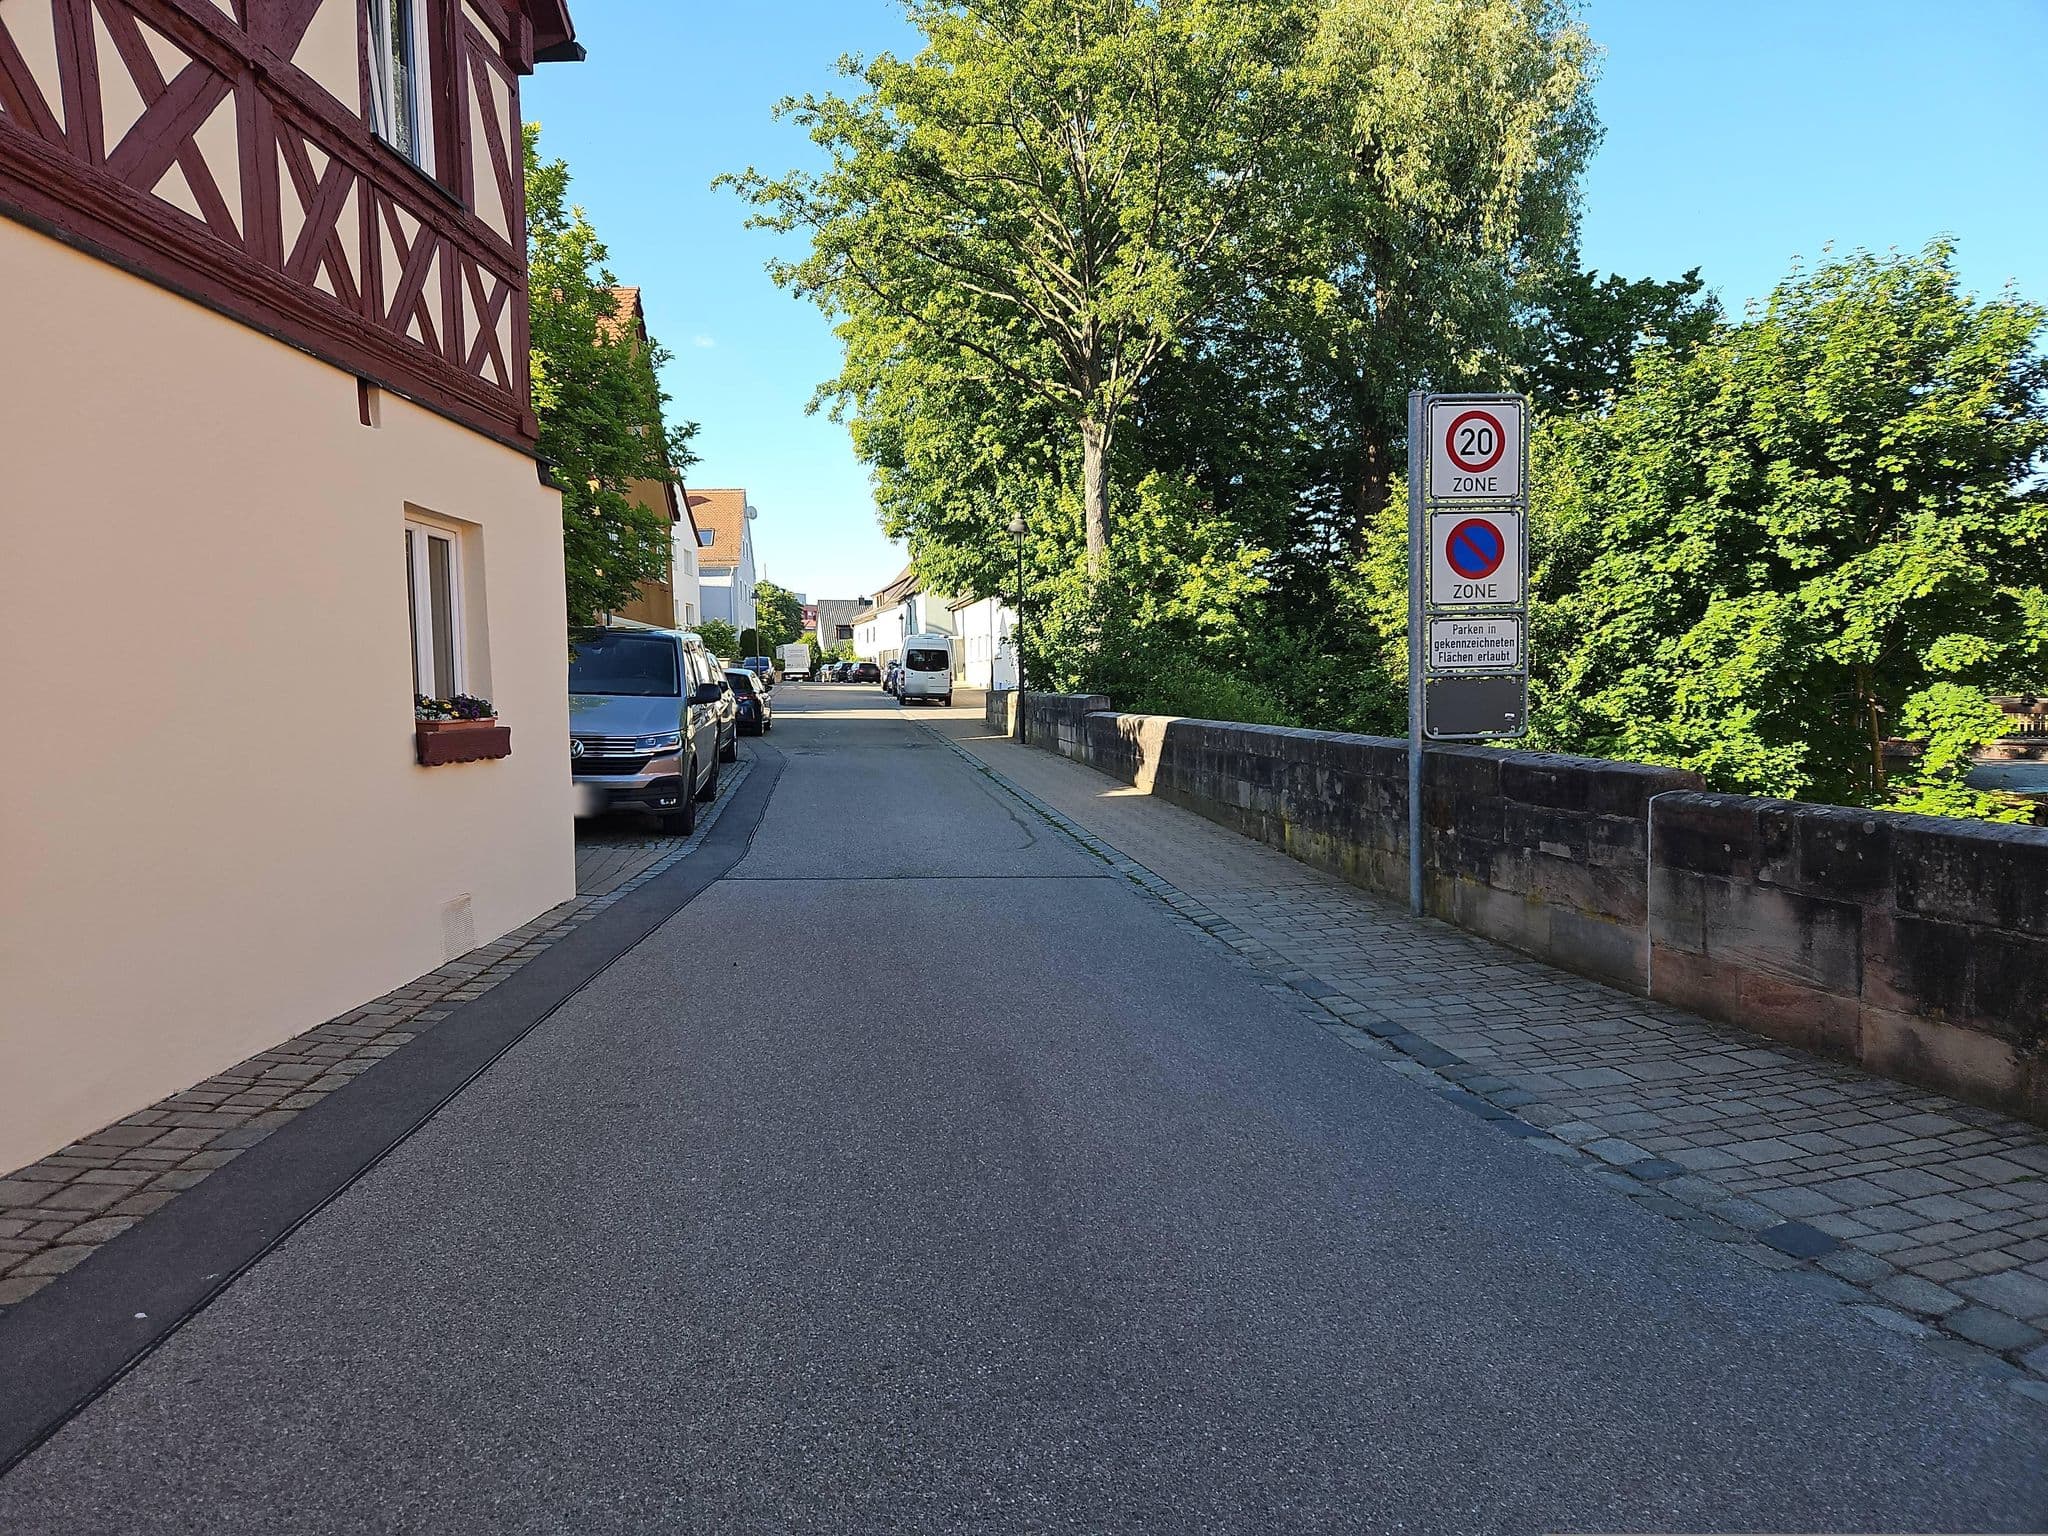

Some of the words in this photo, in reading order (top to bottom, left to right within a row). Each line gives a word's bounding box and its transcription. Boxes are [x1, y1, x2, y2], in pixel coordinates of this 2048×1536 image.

[1460, 428, 1493, 455] 20
[1453, 477, 1497, 492] ZONE
[1453, 584, 1497, 598] ZONE
[1452, 624, 1484, 635] Parken
[1488, 624, 1496, 634] in
[1434, 637, 1515, 651] gekennzeichneten
[1438, 651, 1473, 662] Flächen
[1478, 651, 1510, 661] erlaubt
